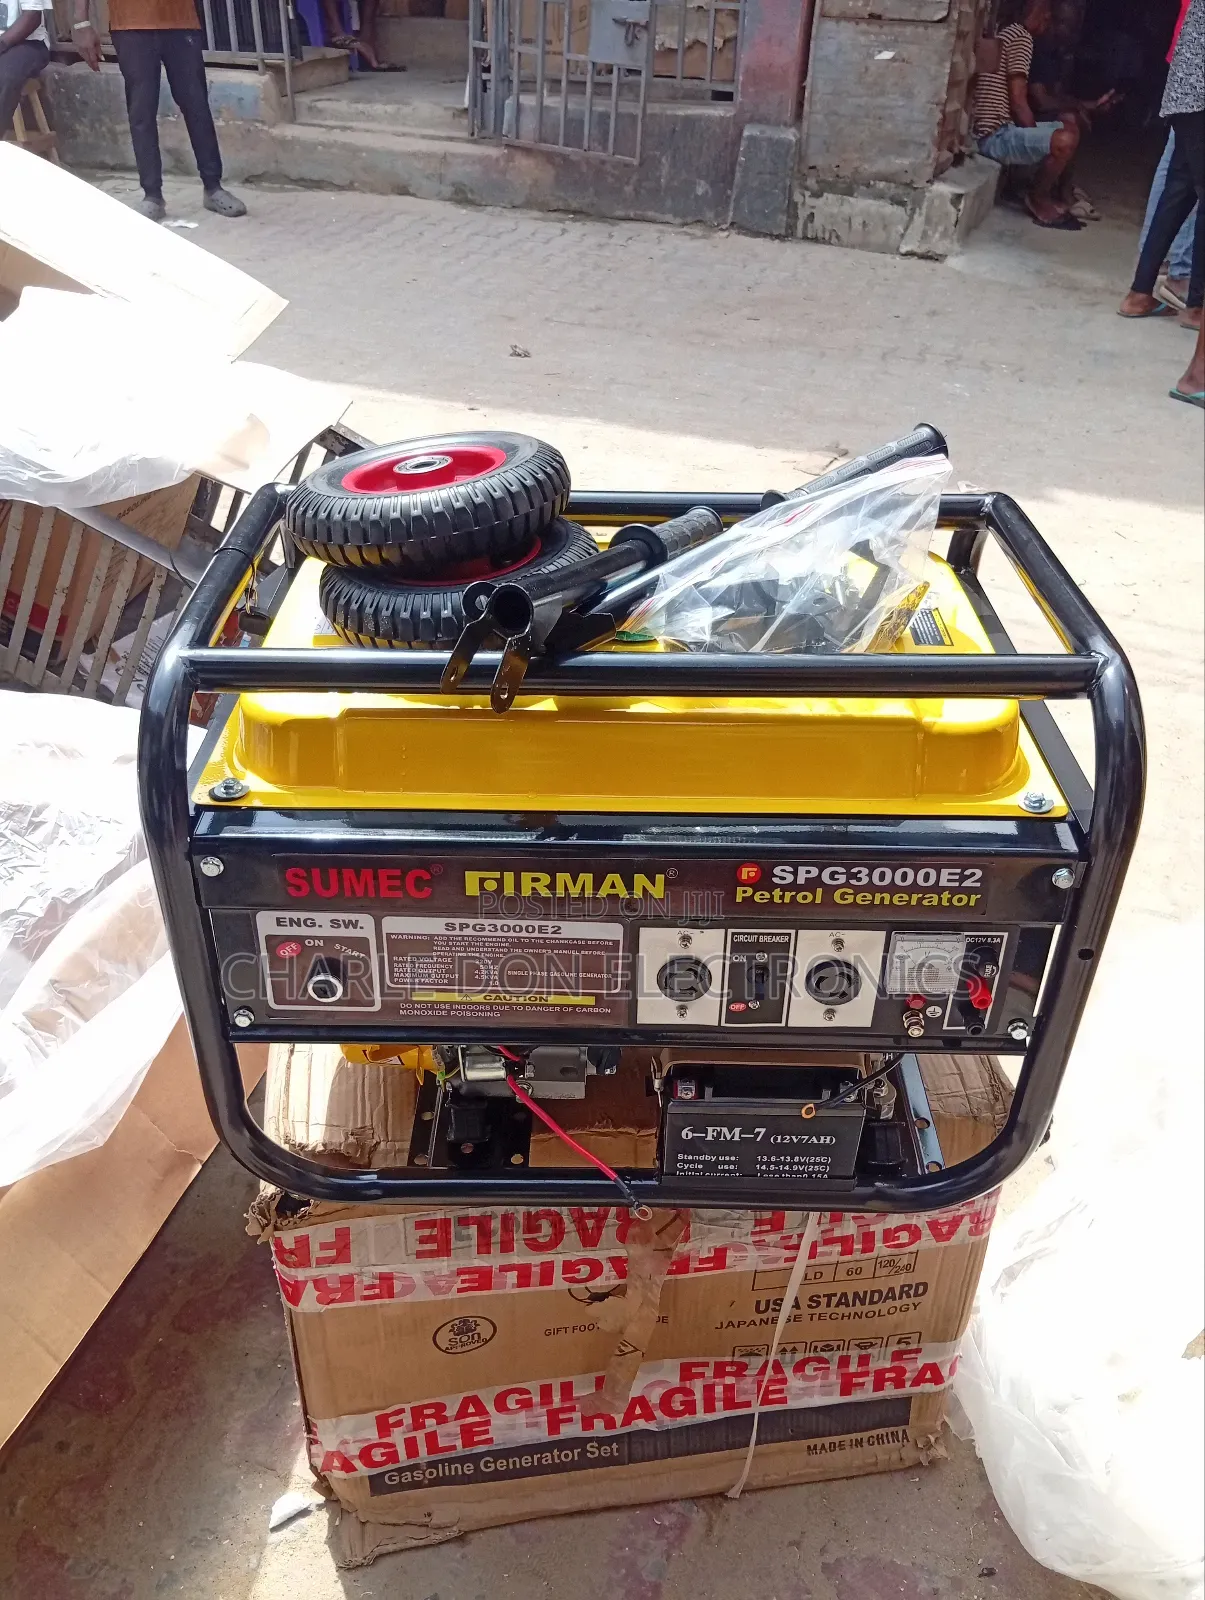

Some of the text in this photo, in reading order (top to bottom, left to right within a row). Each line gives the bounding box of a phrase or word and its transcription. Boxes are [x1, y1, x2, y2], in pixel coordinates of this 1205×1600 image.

[285, 867, 433, 899] SUMEC
[771, 866, 982, 888] SPG3000E2
[465, 870, 665, 899] FIRMAN
[735, 887, 981, 908] Petrol Generator
[276, 917, 364, 930] ENG. SW.
[444, 922, 562, 935] SPG3000E2
[305, 939, 323, 947] ON
[733, 934, 790, 943] CIRCUIT BREAKER
[280, 943, 298, 957] OFF
[334, 943, 366, 959] START
[984, 964, 993, 977] FUSE
[483, 994, 549, 1003] CAUTION
[770, 1135, 836, 1145] (12V7AH)
[677, 1153, 717, 1162] Standby
[676, 1162, 703, 1170] Cycle
[846, 1266, 863, 1277] 60
[754, 1281, 929, 1315] USA STANDARD
[714, 1302, 922, 1330] JAPANESE TECHNOLOGY
[544, 1326, 570, 1337] GIFT
[806, 1429, 911, 1457] MADE IN CHINA
[384, 1440, 619, 1485] Gasoline Generator Set
